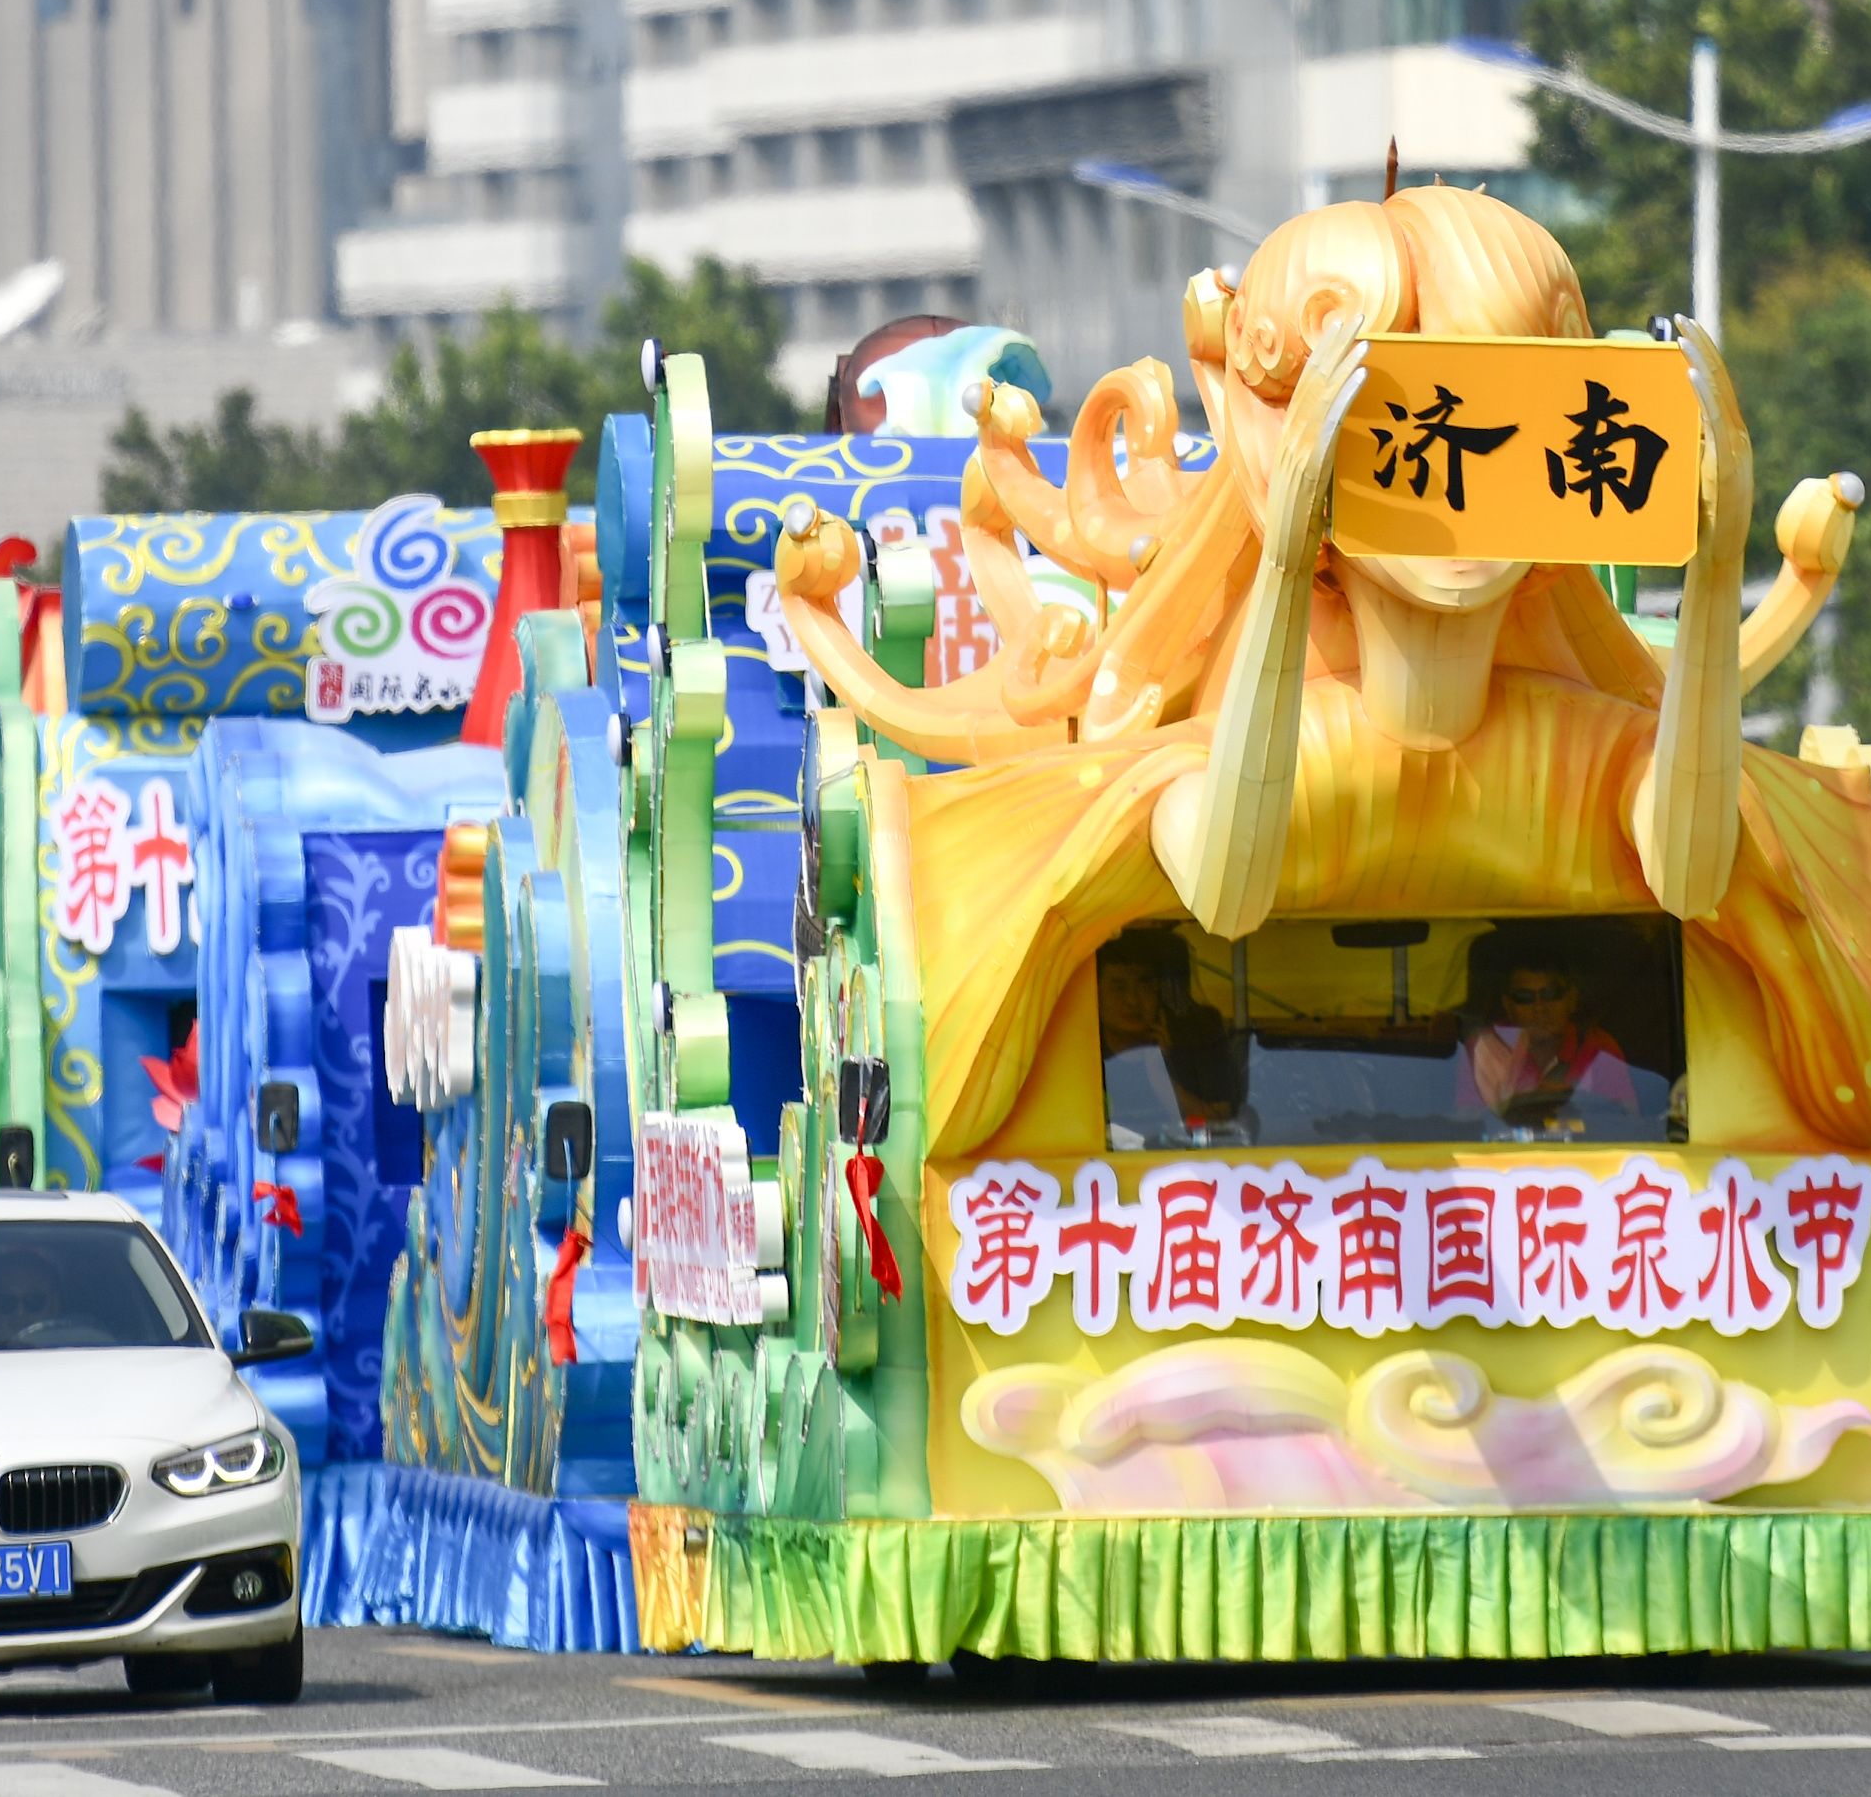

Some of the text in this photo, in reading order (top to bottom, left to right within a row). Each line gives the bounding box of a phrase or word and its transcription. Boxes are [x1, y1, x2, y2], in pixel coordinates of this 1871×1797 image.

[1369, 380, 1669, 518] 济南
[349, 671, 472, 703] 国际泉水
[967, 1173, 1863, 1320] 第十届济南国际泉水节
